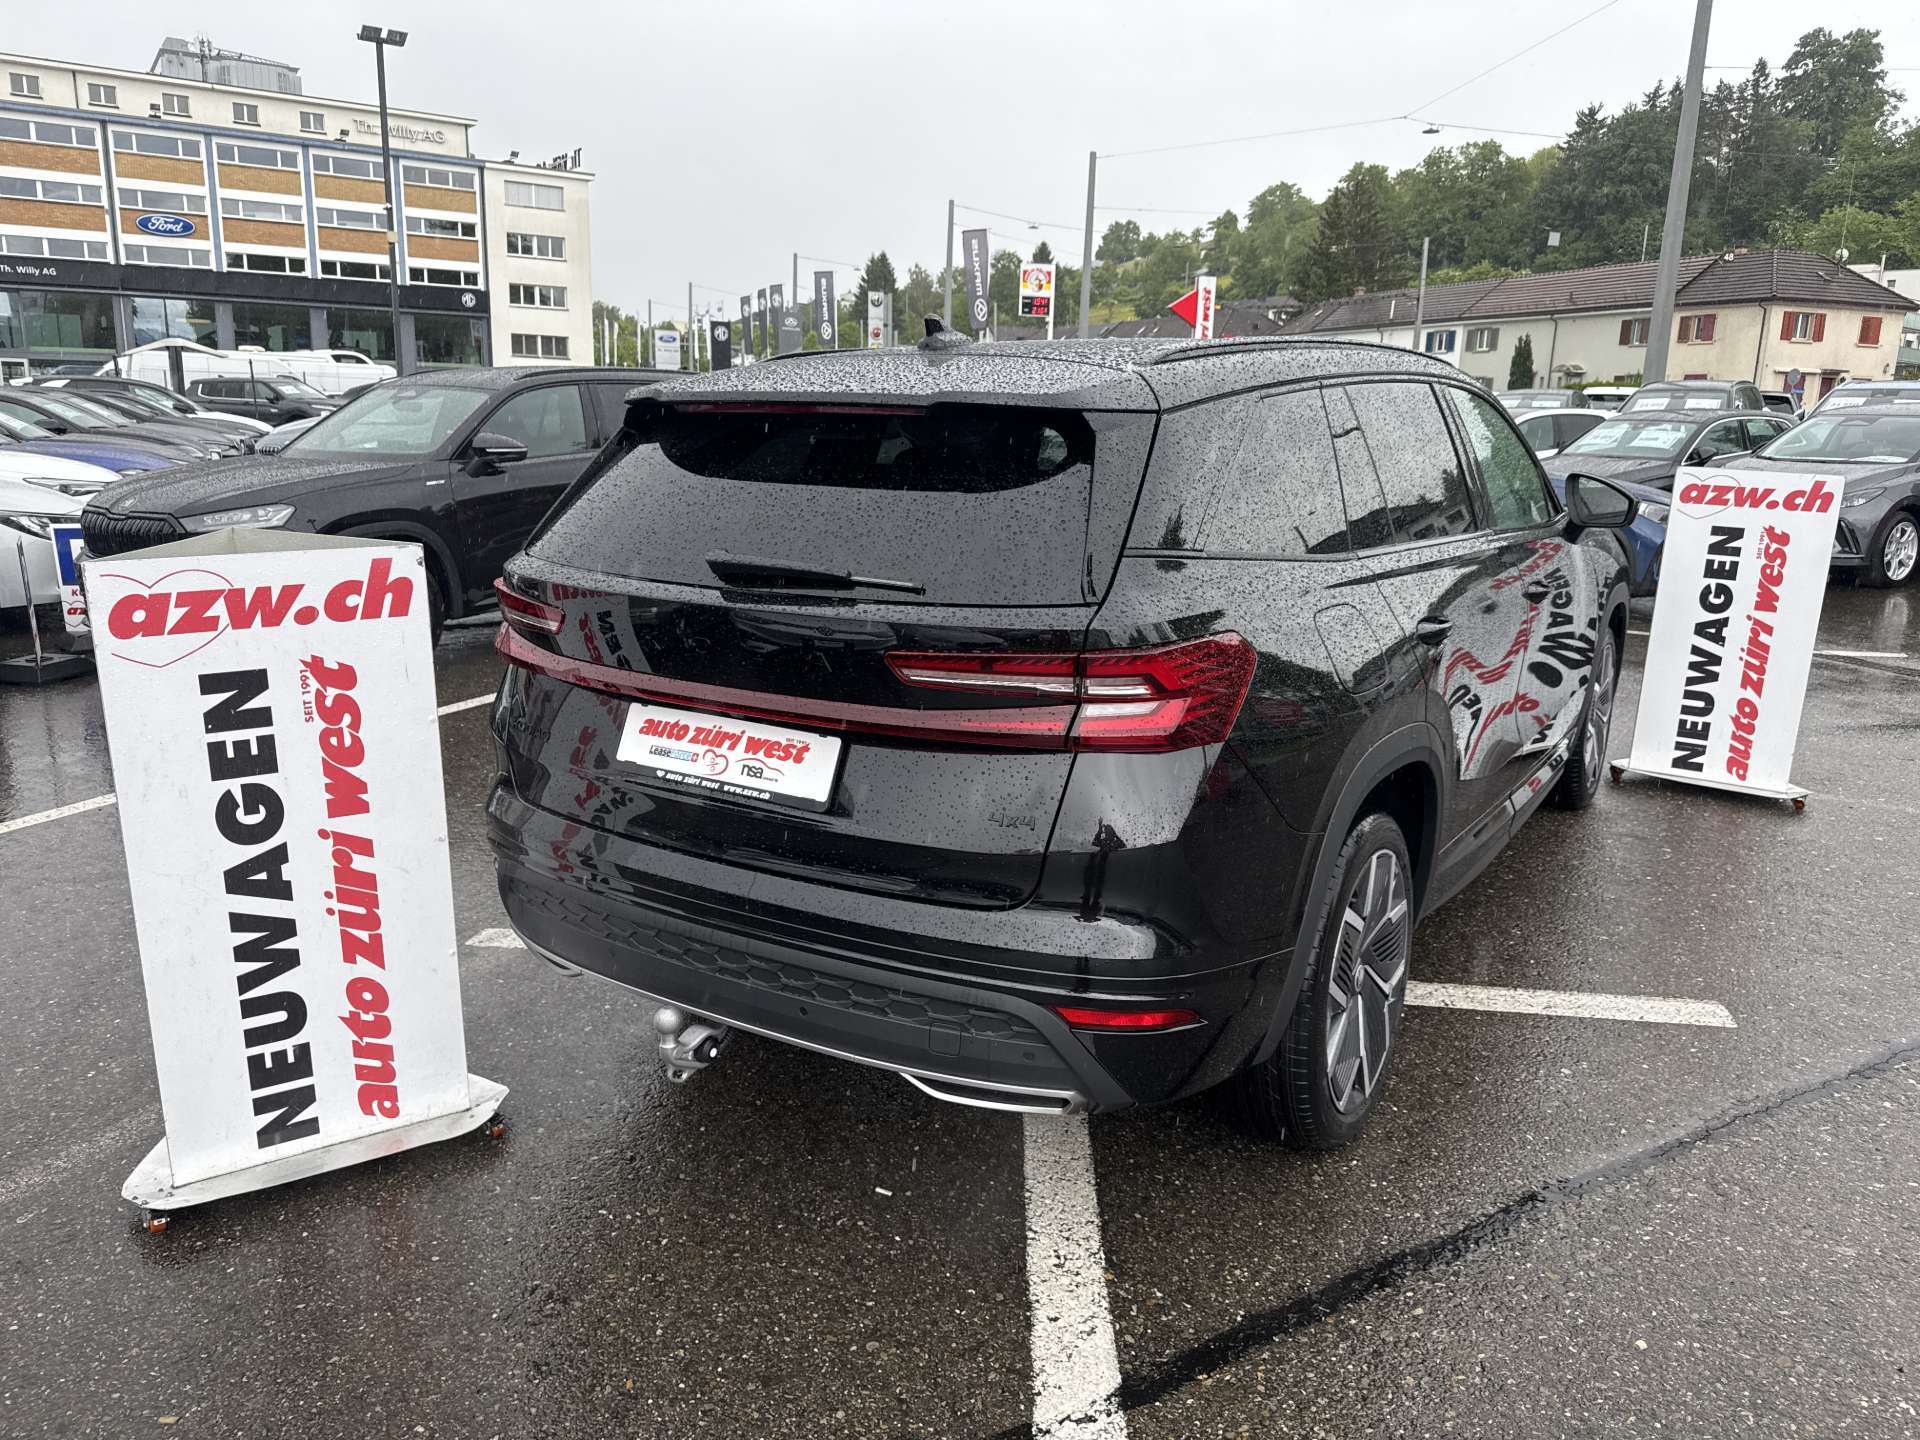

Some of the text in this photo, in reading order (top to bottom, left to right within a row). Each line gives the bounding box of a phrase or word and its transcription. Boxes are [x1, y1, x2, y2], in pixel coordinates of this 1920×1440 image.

[423, 127, 446, 144] AG
[147, 215, 184, 233] Ford
[16, 265, 40, 277] Willy
[42, 267, 57, 276] AG
[1723, 252, 1735, 262] 48
[714, 324, 729, 342] MG
[1679, 480, 1834, 513] azw.ch
[107, 557, 414, 640] azw.ch
[1671, 525, 1746, 773] NEUWAGEN
[1726, 524, 1791, 782] auto züri west
[300, 668, 315, 724] SEIT 1991
[639, 718, 811, 765] auto züri west
[665, 772, 771, 800] auto züri west www.azw.ch
[740, 764, 764, 779] nsa
[300, 655, 401, 1120] auto züri west
[198, 668, 320, 1149] NEUWAGEN
